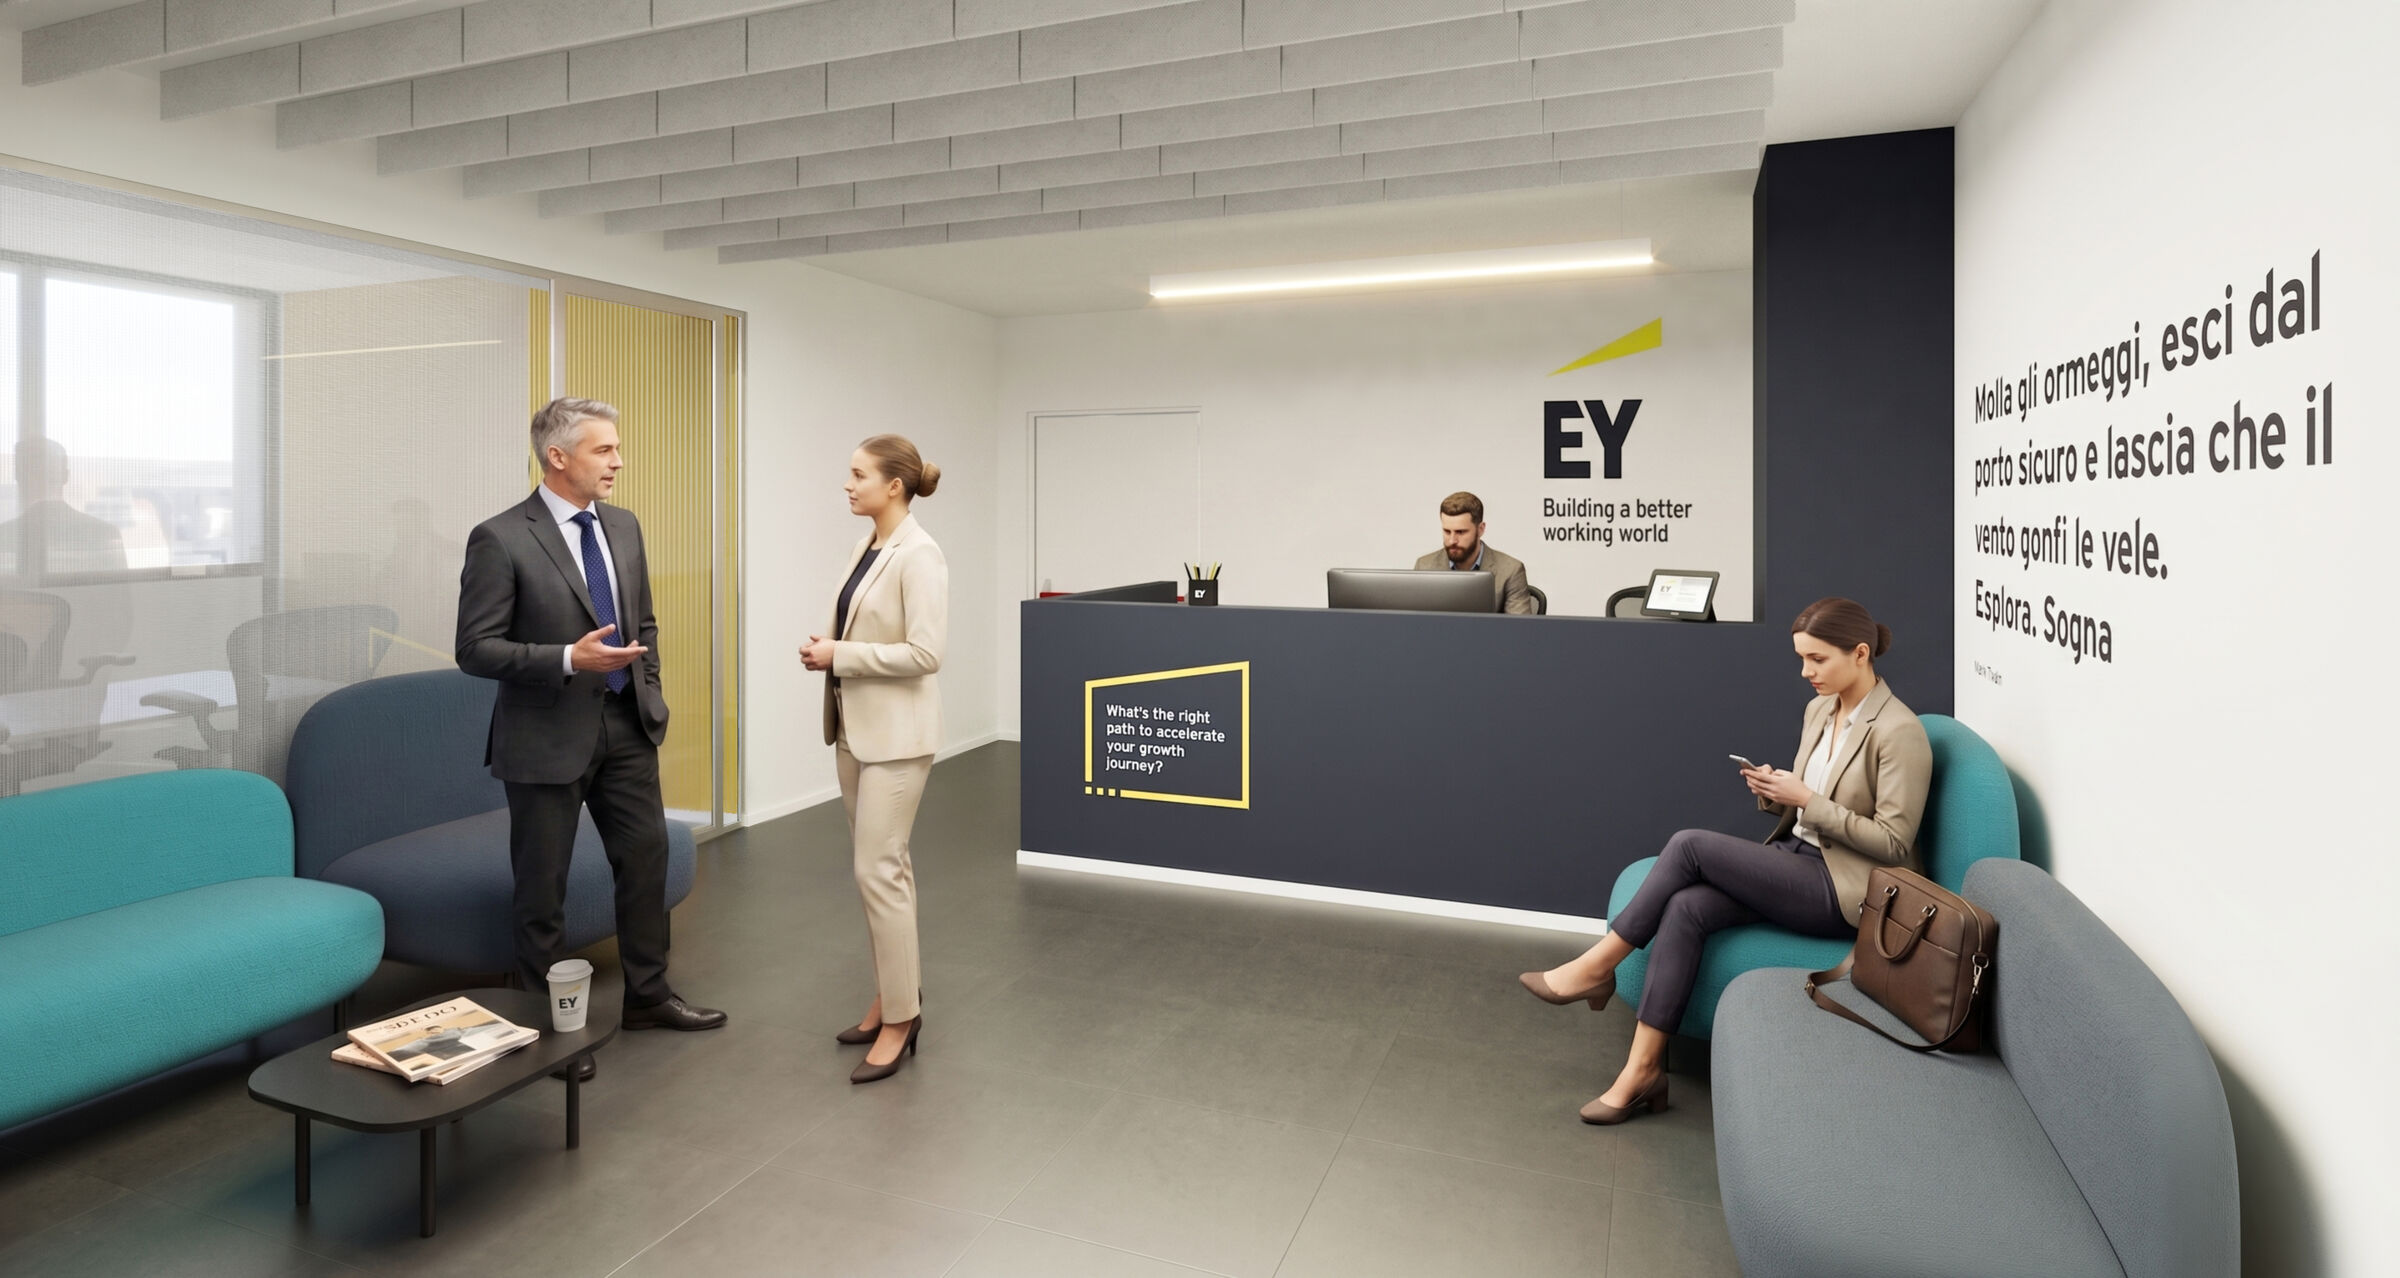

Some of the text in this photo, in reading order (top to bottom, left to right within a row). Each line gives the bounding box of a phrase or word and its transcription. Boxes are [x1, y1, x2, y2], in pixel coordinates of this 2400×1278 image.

[1975, 248, 2321, 424] Molla gli ormeggi, esci dal
[1543, 398, 1643, 479] EY
[1975, 381, 2333, 496] porto sicuro e lascia che il
[1543, 498, 1692, 523] Building a better
[1543, 523, 1668, 547] working world
[1975, 515, 2168, 580] vento gonfi le vele.
[1975, 579, 2112, 665] Esplora. Sogna
[1106, 704, 1211, 725] What's the right
[1106, 723, 1225, 742] path to accelerate
[1106, 741, 1185, 757] your growth
[1105, 756, 1163, 775] journey?
[558, 996, 578, 1009] EY
